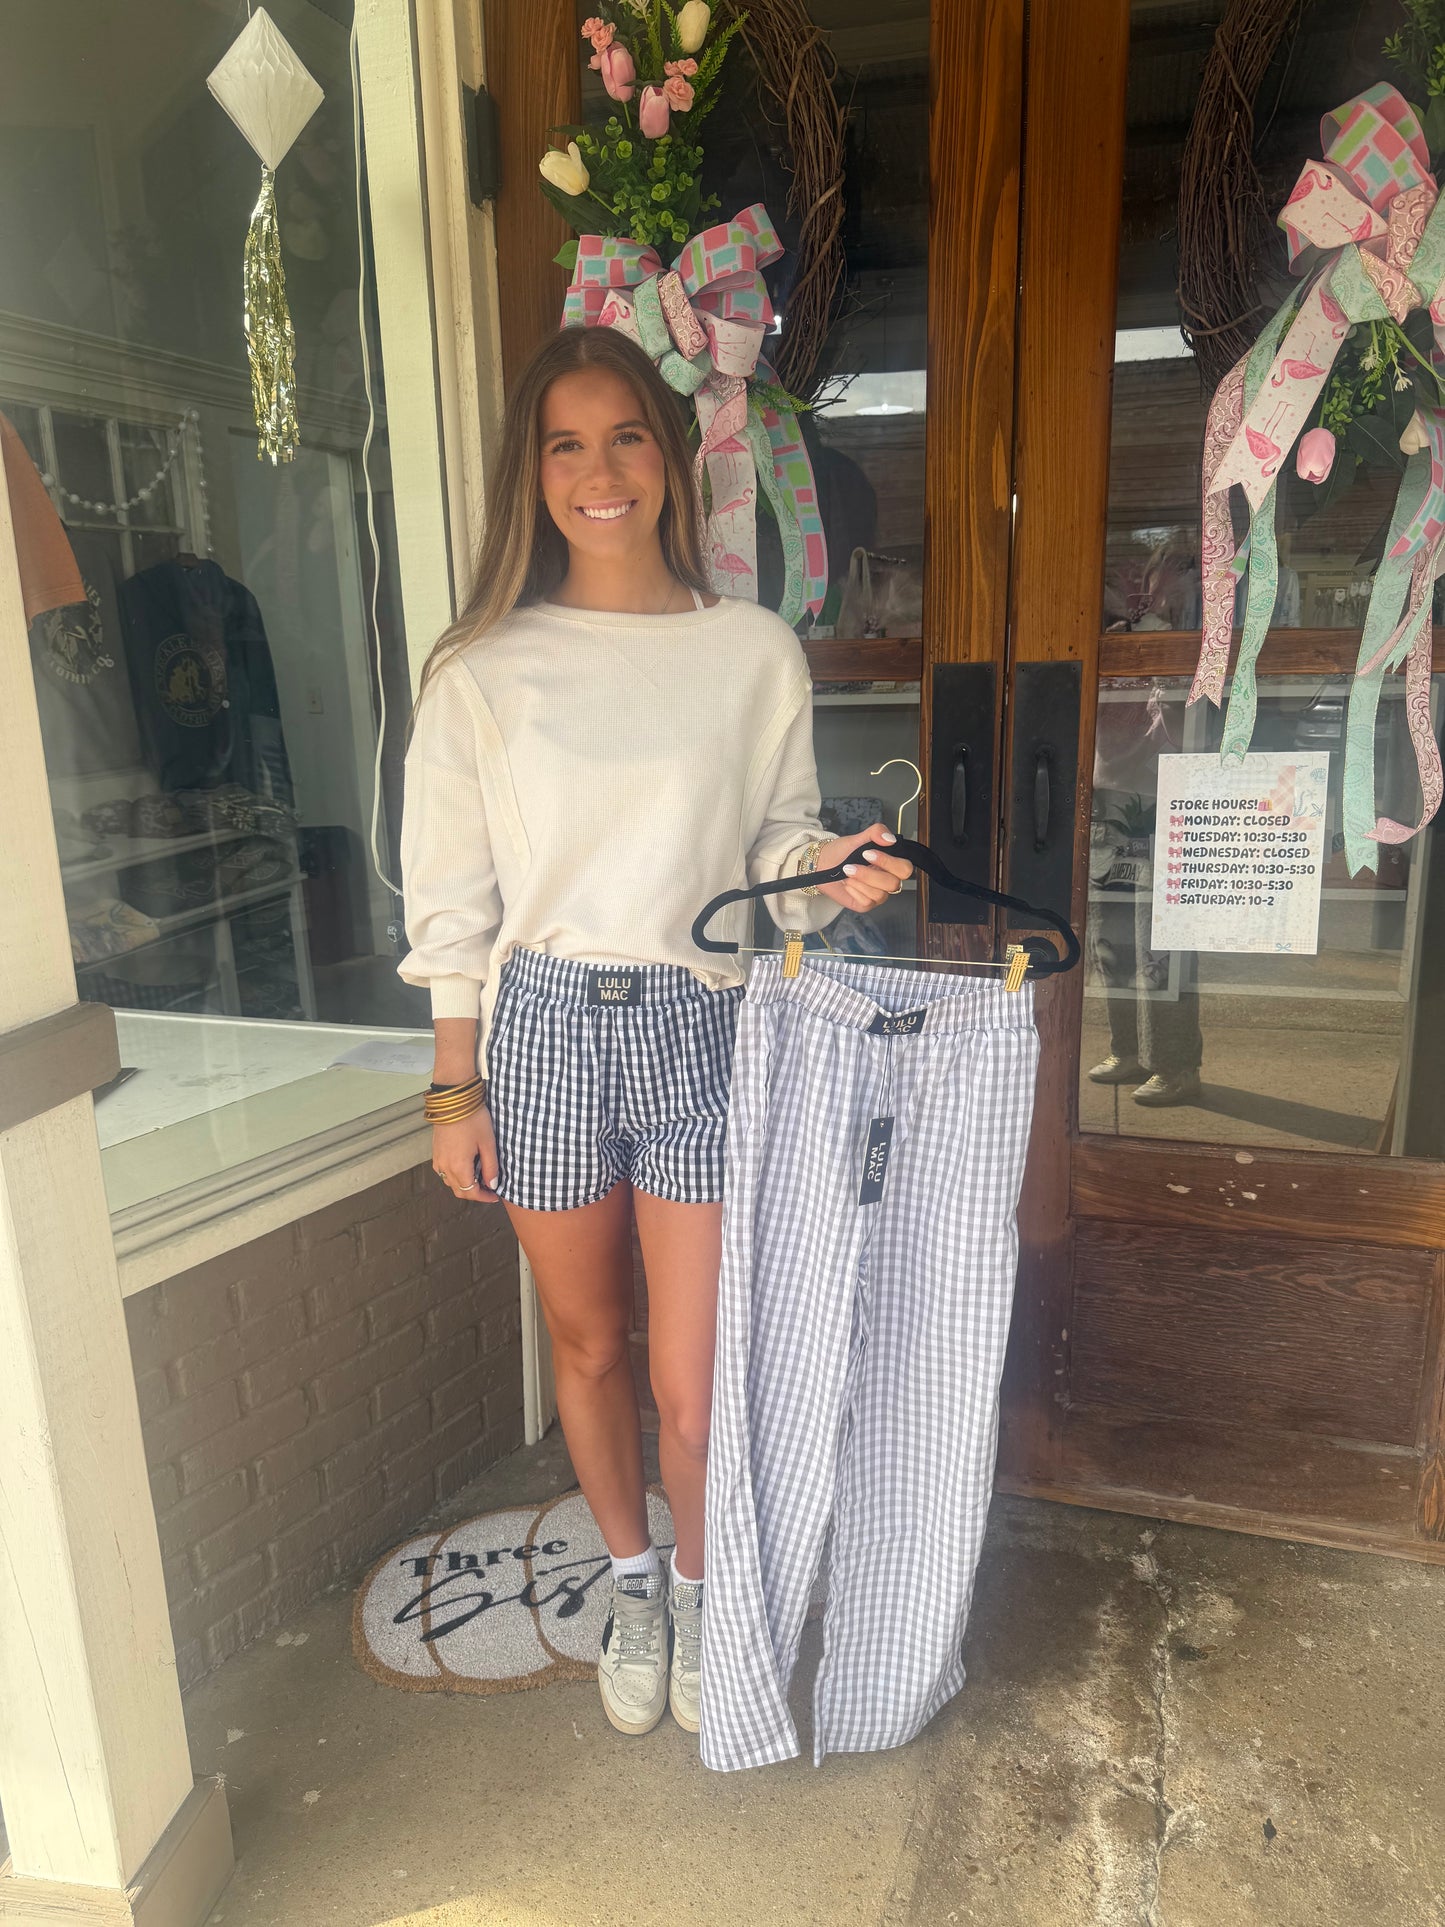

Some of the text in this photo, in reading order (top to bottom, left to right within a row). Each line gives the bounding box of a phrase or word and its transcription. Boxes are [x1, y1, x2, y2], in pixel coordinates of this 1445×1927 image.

[1170, 799, 1258, 810] STORE HOURS!
[1184, 815, 1290, 826] MONDAY: CLOSED
[1184, 832, 1307, 843] TUESDAY: 10:30-5:30
[1183, 847, 1310, 859] WEDNESDAY: CLOSED
[1182, 863, 1315, 875] THURSDAY: 10:30-5:30
[1181, 879, 1293, 890] FRIDAY: 10:30-5:30
[1180, 894, 1274, 906] SATURDAY: 10-2
[597, 977, 631, 989] LULU
[600, 989, 628, 1000] MAC
[867, 1146, 879, 1181] MAC
[874, 1142, 886, 1183] LULU
[400, 1539, 568, 1578] Three
[626, 1579, 643, 1590] GGDB
